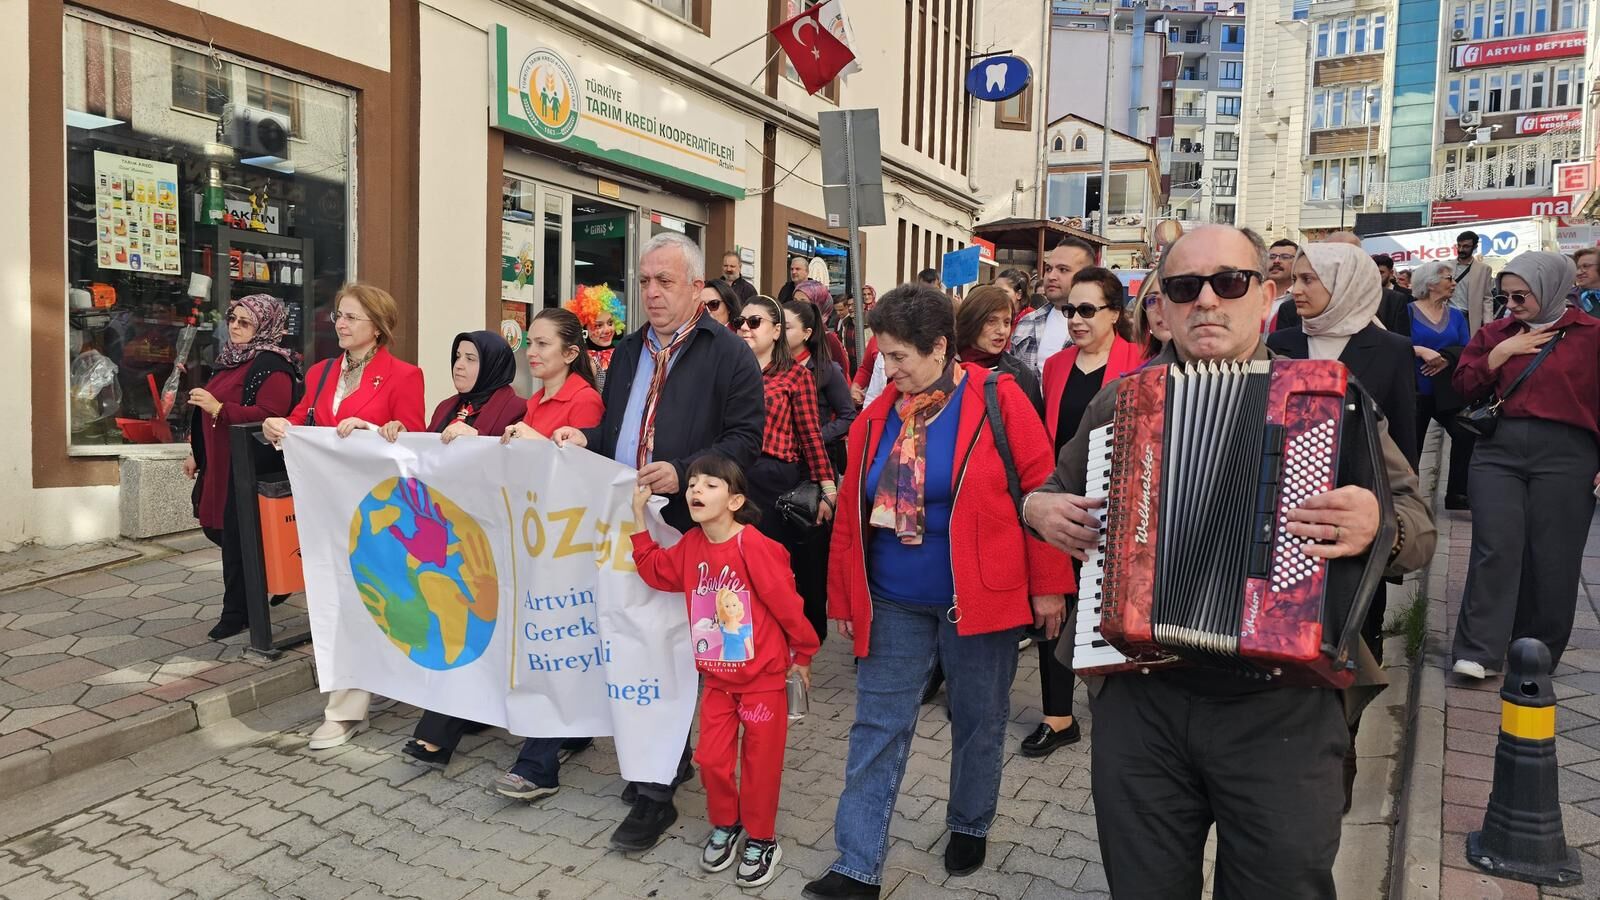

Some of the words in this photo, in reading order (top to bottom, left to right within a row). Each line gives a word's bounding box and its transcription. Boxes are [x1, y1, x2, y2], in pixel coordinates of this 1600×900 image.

[1486, 44, 1531, 57] ARTVİN
[585, 79, 622, 103] TÜRKİYE
[585, 96, 622, 123] TARIM
[625, 110, 657, 135] KREDİ
[659, 123, 735, 162] KOOPERATİFLERİ
[719, 159, 735, 171] Artvin
[1565, 168, 1584, 189] E
[590, 223, 607, 236] GİRİŞ
[1371, 244, 1460, 263] arket
[1135, 444, 1153, 544] Weltmeister
[696, 561, 746, 597] Barbie
[524, 587, 595, 611] Artvin
[698, 660, 746, 668] CALIFORNIA
[737, 702, 774, 724] Barbie
